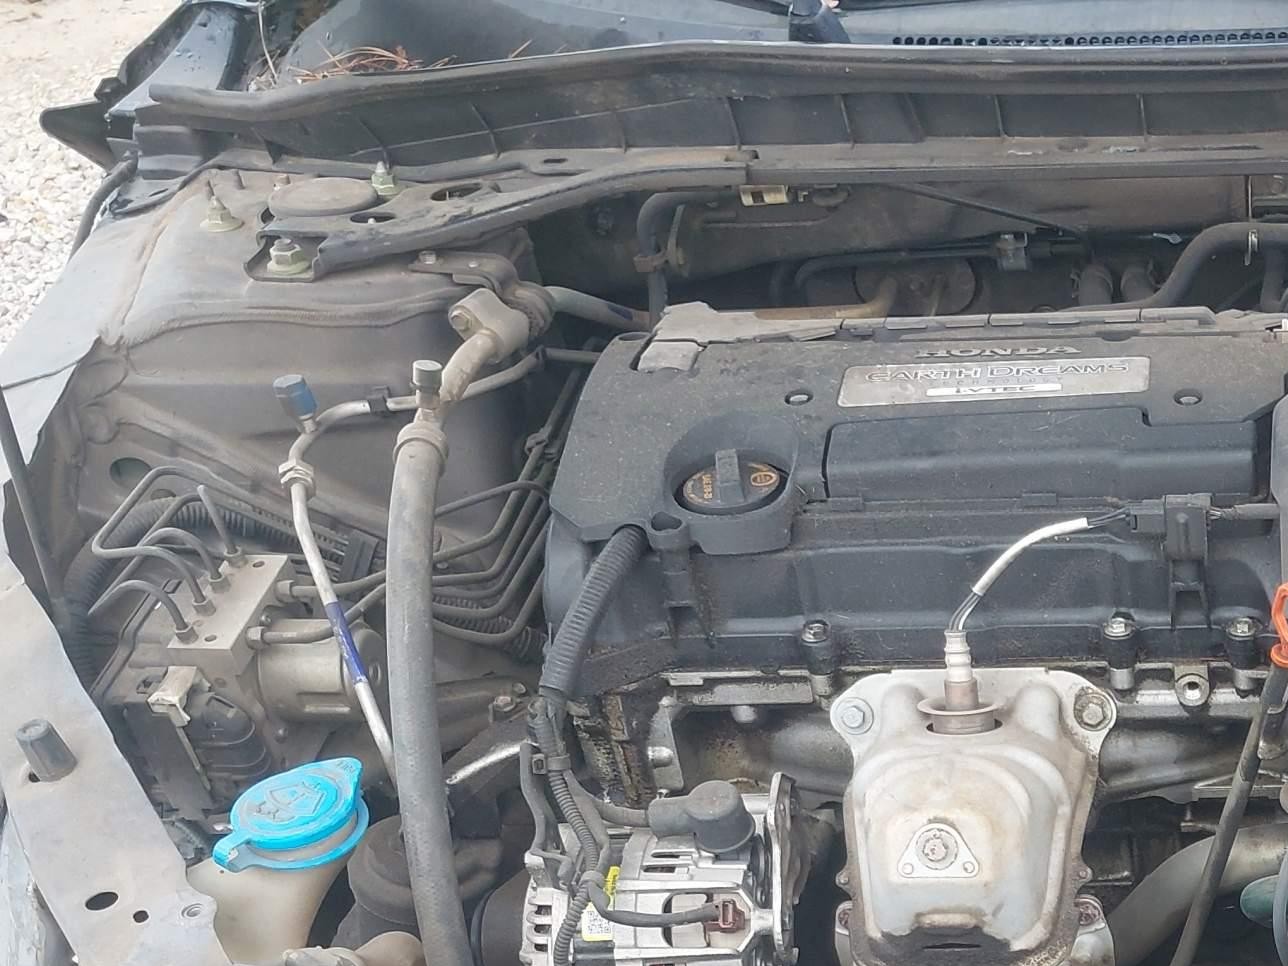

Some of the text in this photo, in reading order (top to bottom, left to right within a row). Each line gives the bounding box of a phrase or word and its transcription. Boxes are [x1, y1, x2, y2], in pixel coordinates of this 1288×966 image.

[915, 345, 1081, 359] HONDA
[866, 363, 1129, 382] EARTH DREAMS
